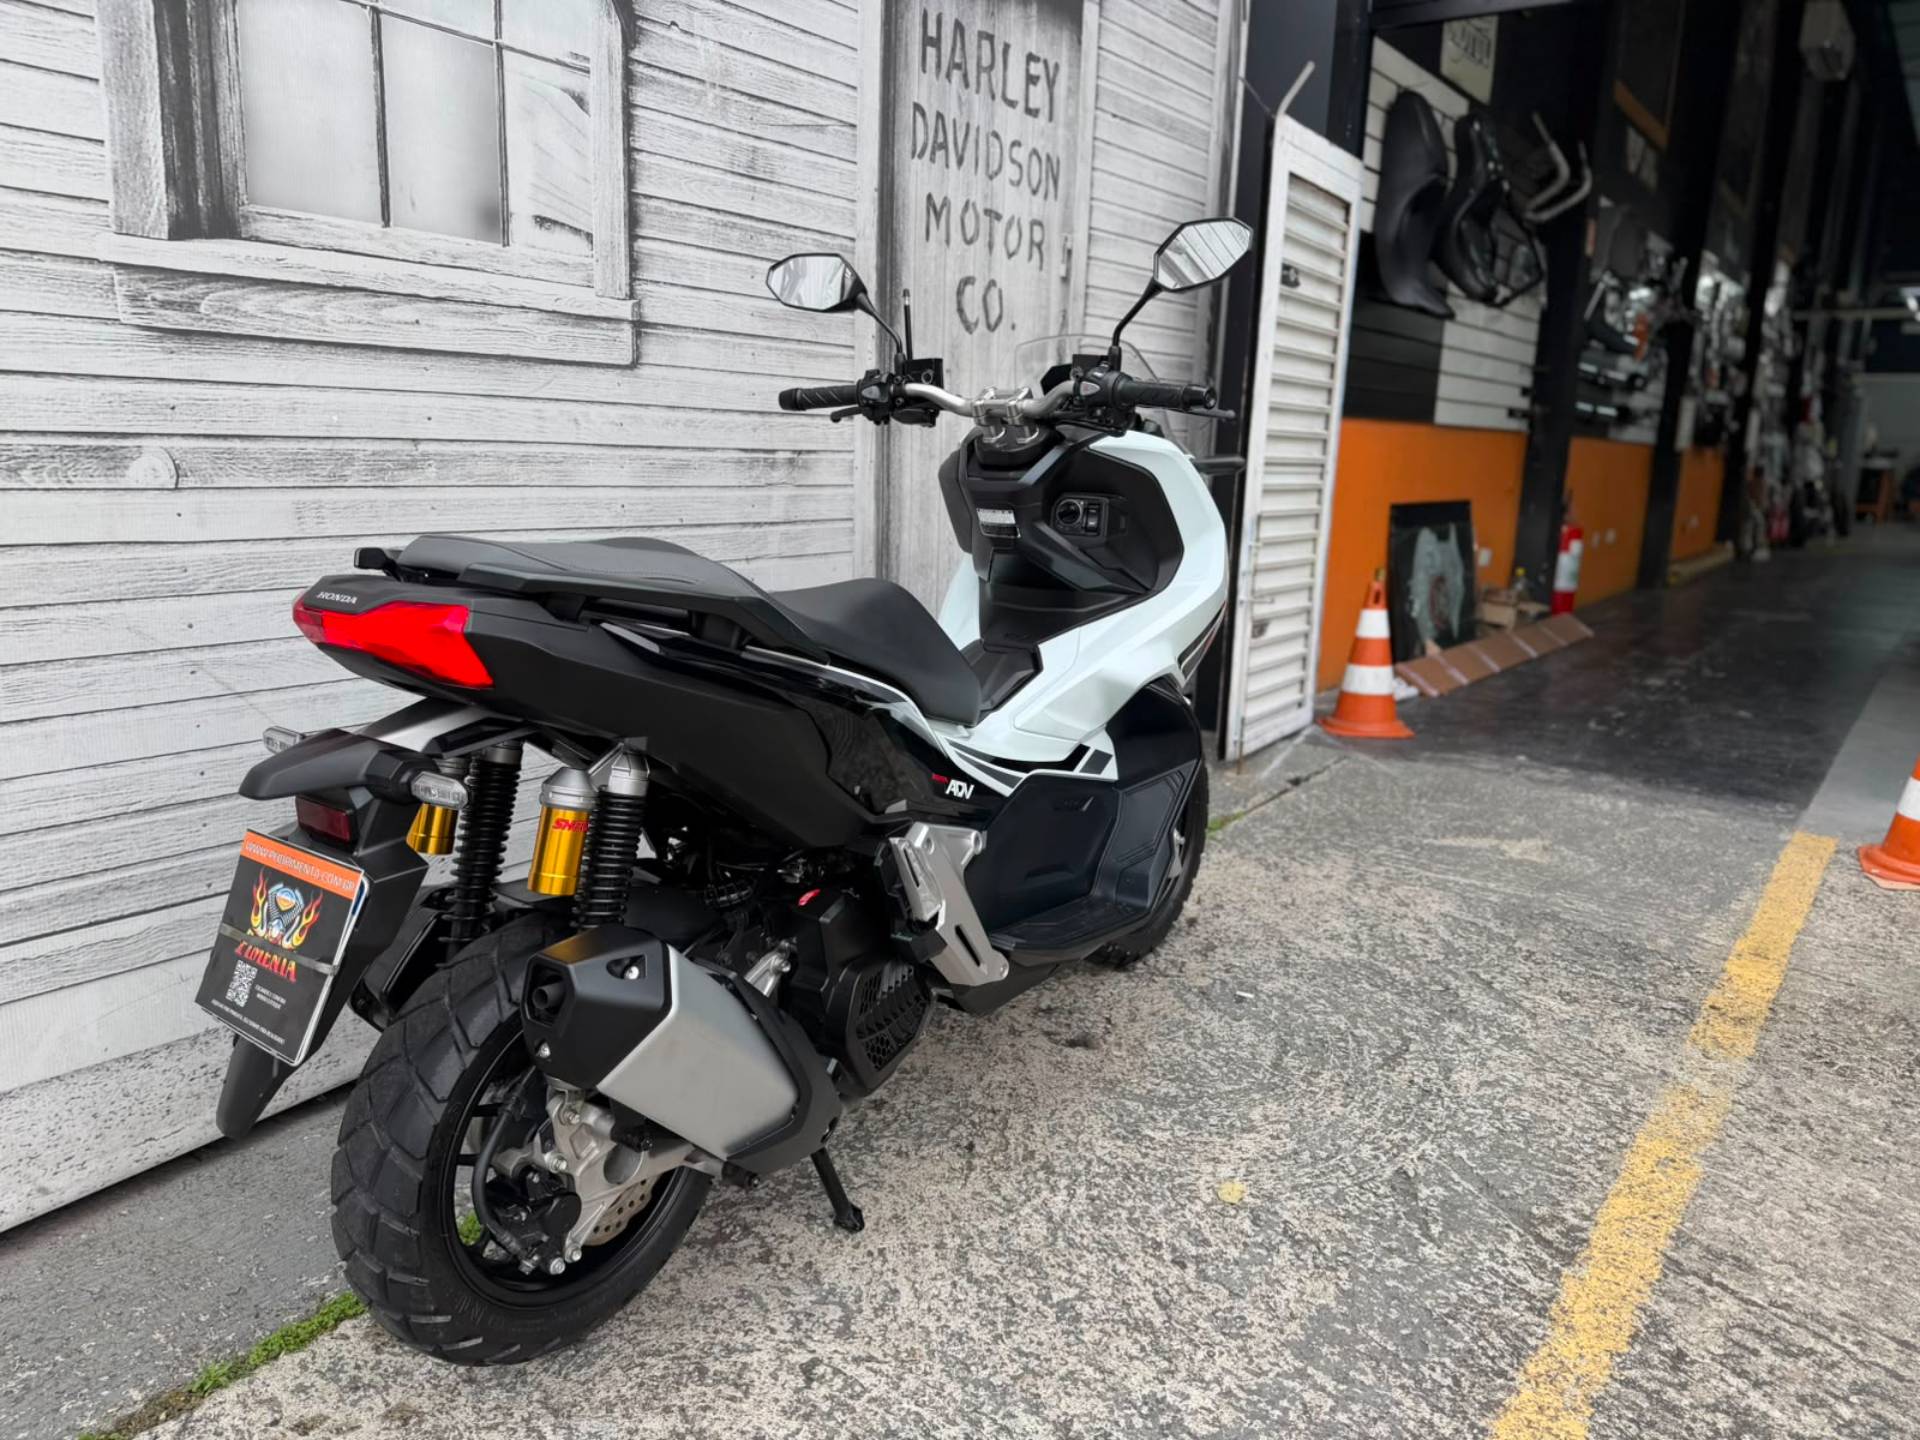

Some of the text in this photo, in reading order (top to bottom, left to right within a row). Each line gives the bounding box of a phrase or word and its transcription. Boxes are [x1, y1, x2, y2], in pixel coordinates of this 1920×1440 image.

[920, 8, 1060, 123] HARLEY
[911, 101, 1060, 201] DAVIDSON
[925, 192, 1045, 271] MOTOR
[956, 276, 1016, 334] CO.
[316, 591, 357, 604] HONDA
[945, 779, 974, 799] ADV
